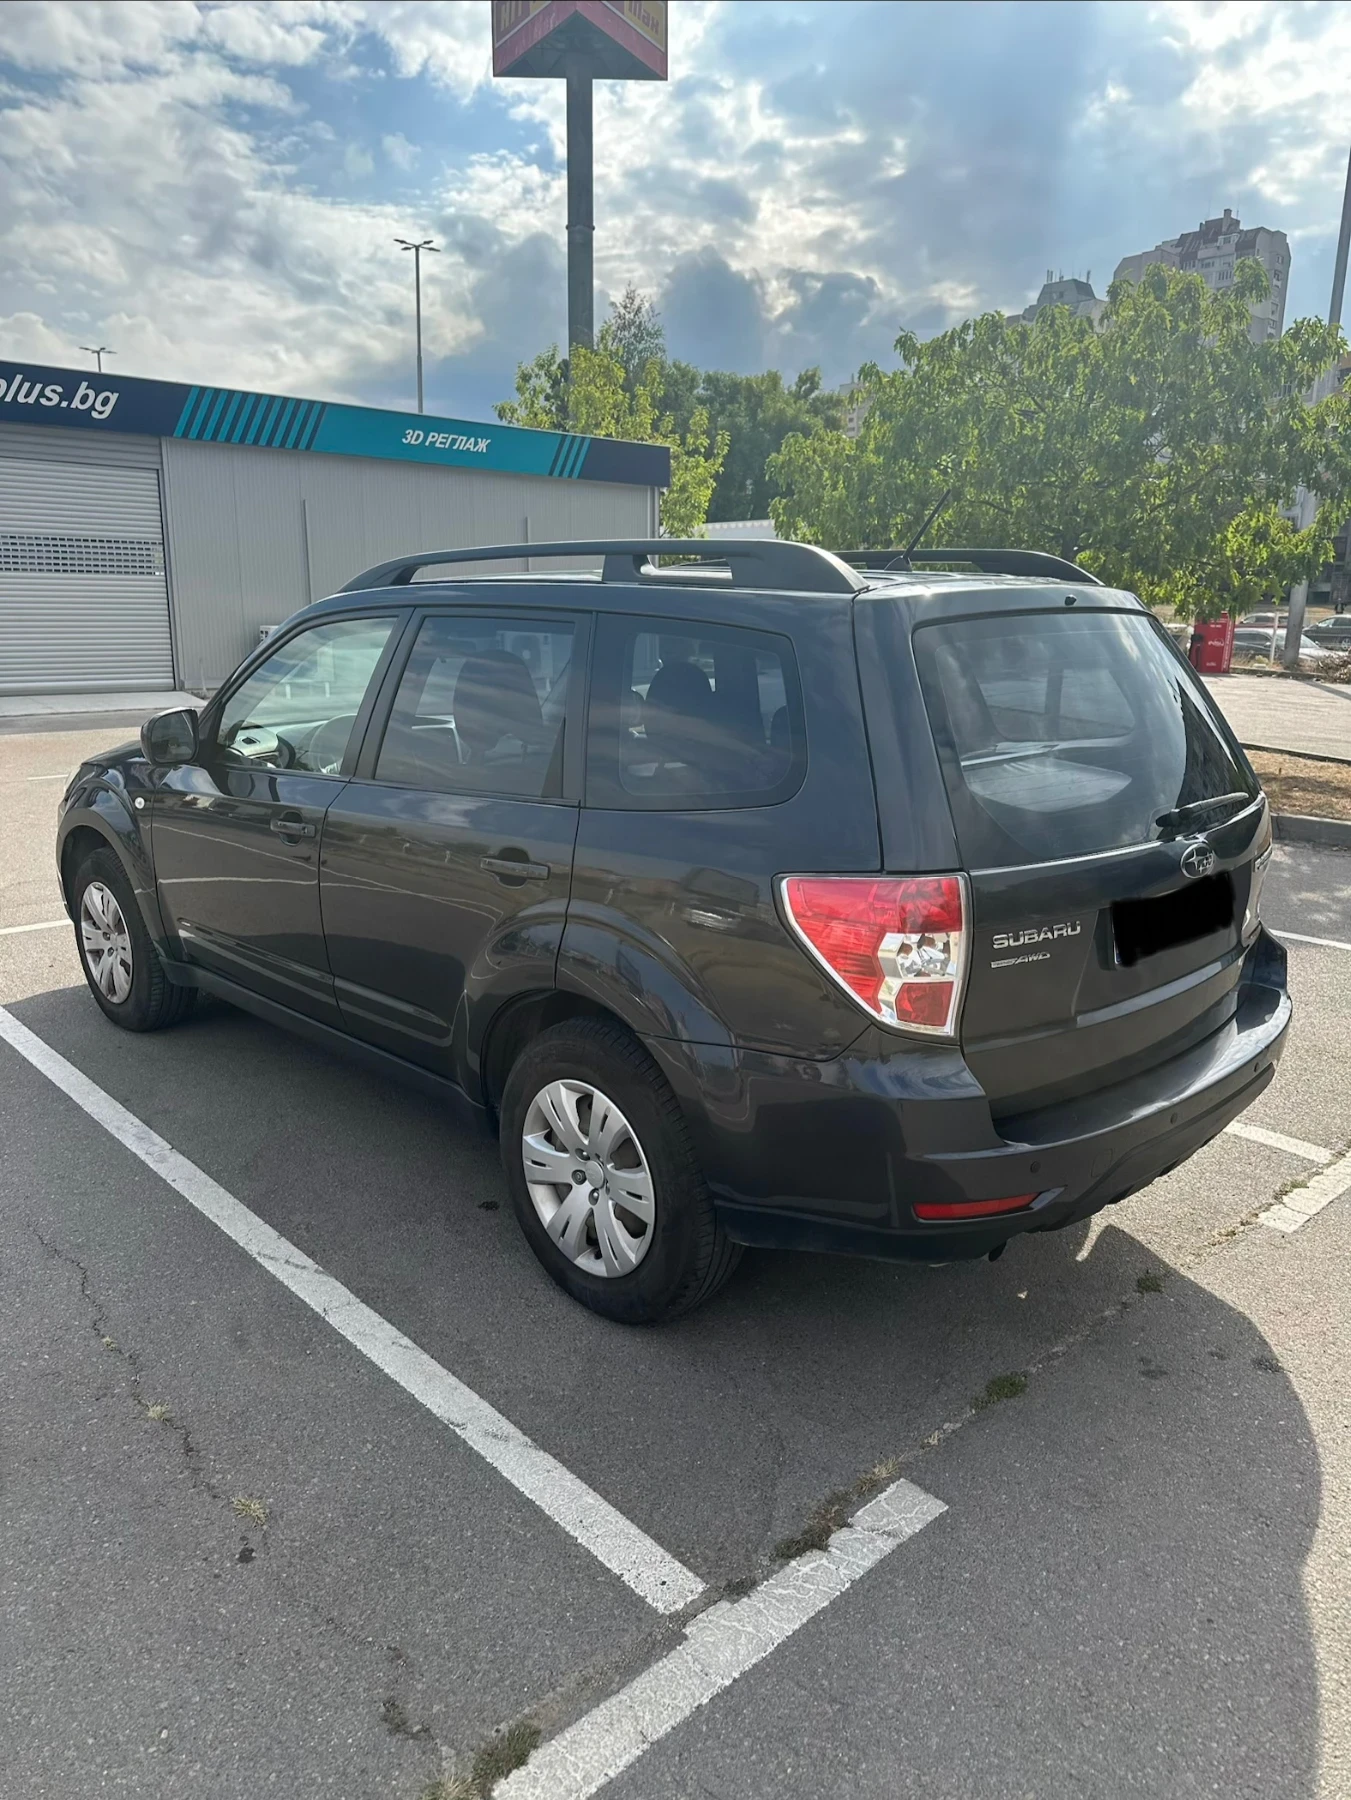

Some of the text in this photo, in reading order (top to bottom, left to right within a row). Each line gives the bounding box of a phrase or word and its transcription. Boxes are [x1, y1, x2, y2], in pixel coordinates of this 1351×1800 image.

[402, 429, 491, 453] 3D РЕГЛАЖ
[992, 921, 1081, 949] SUBARU
[1015, 951, 1051, 965] AWD
